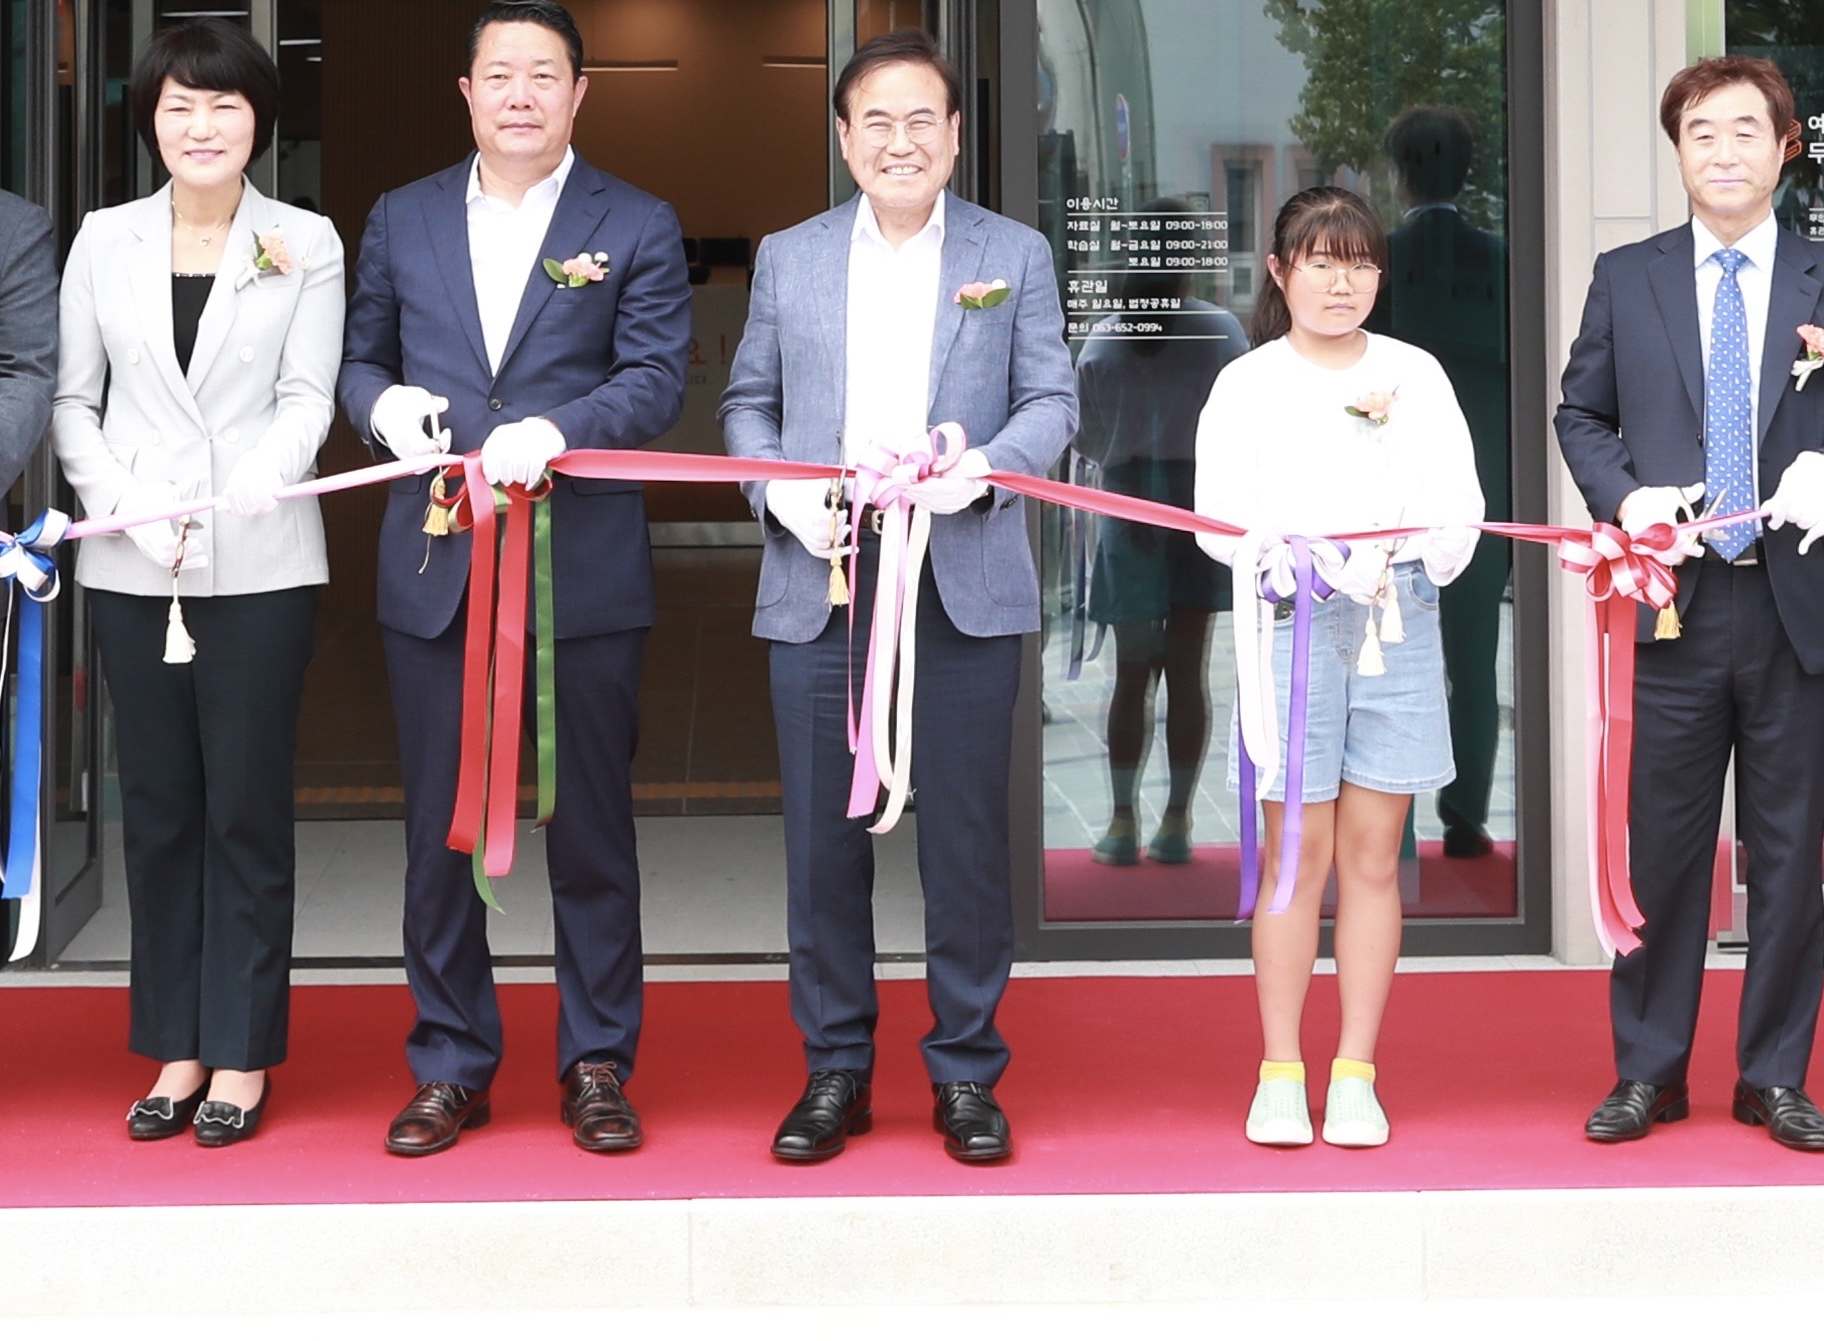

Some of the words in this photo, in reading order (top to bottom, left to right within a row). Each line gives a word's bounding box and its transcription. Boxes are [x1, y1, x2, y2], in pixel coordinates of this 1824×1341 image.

[1066, 196, 1119, 210] 이용시간
[1066, 220, 1100, 231] 자료실
[1066, 239, 1100, 251] 학습실
[1128, 257, 1161, 267] 토요일
[1068, 279, 1108, 293] 휴관일
[1067, 298, 1088, 309] 매주
[1128, 297, 1180, 309] 법정공휴일
[1092, 323, 1162, 333] 063-652-0994
